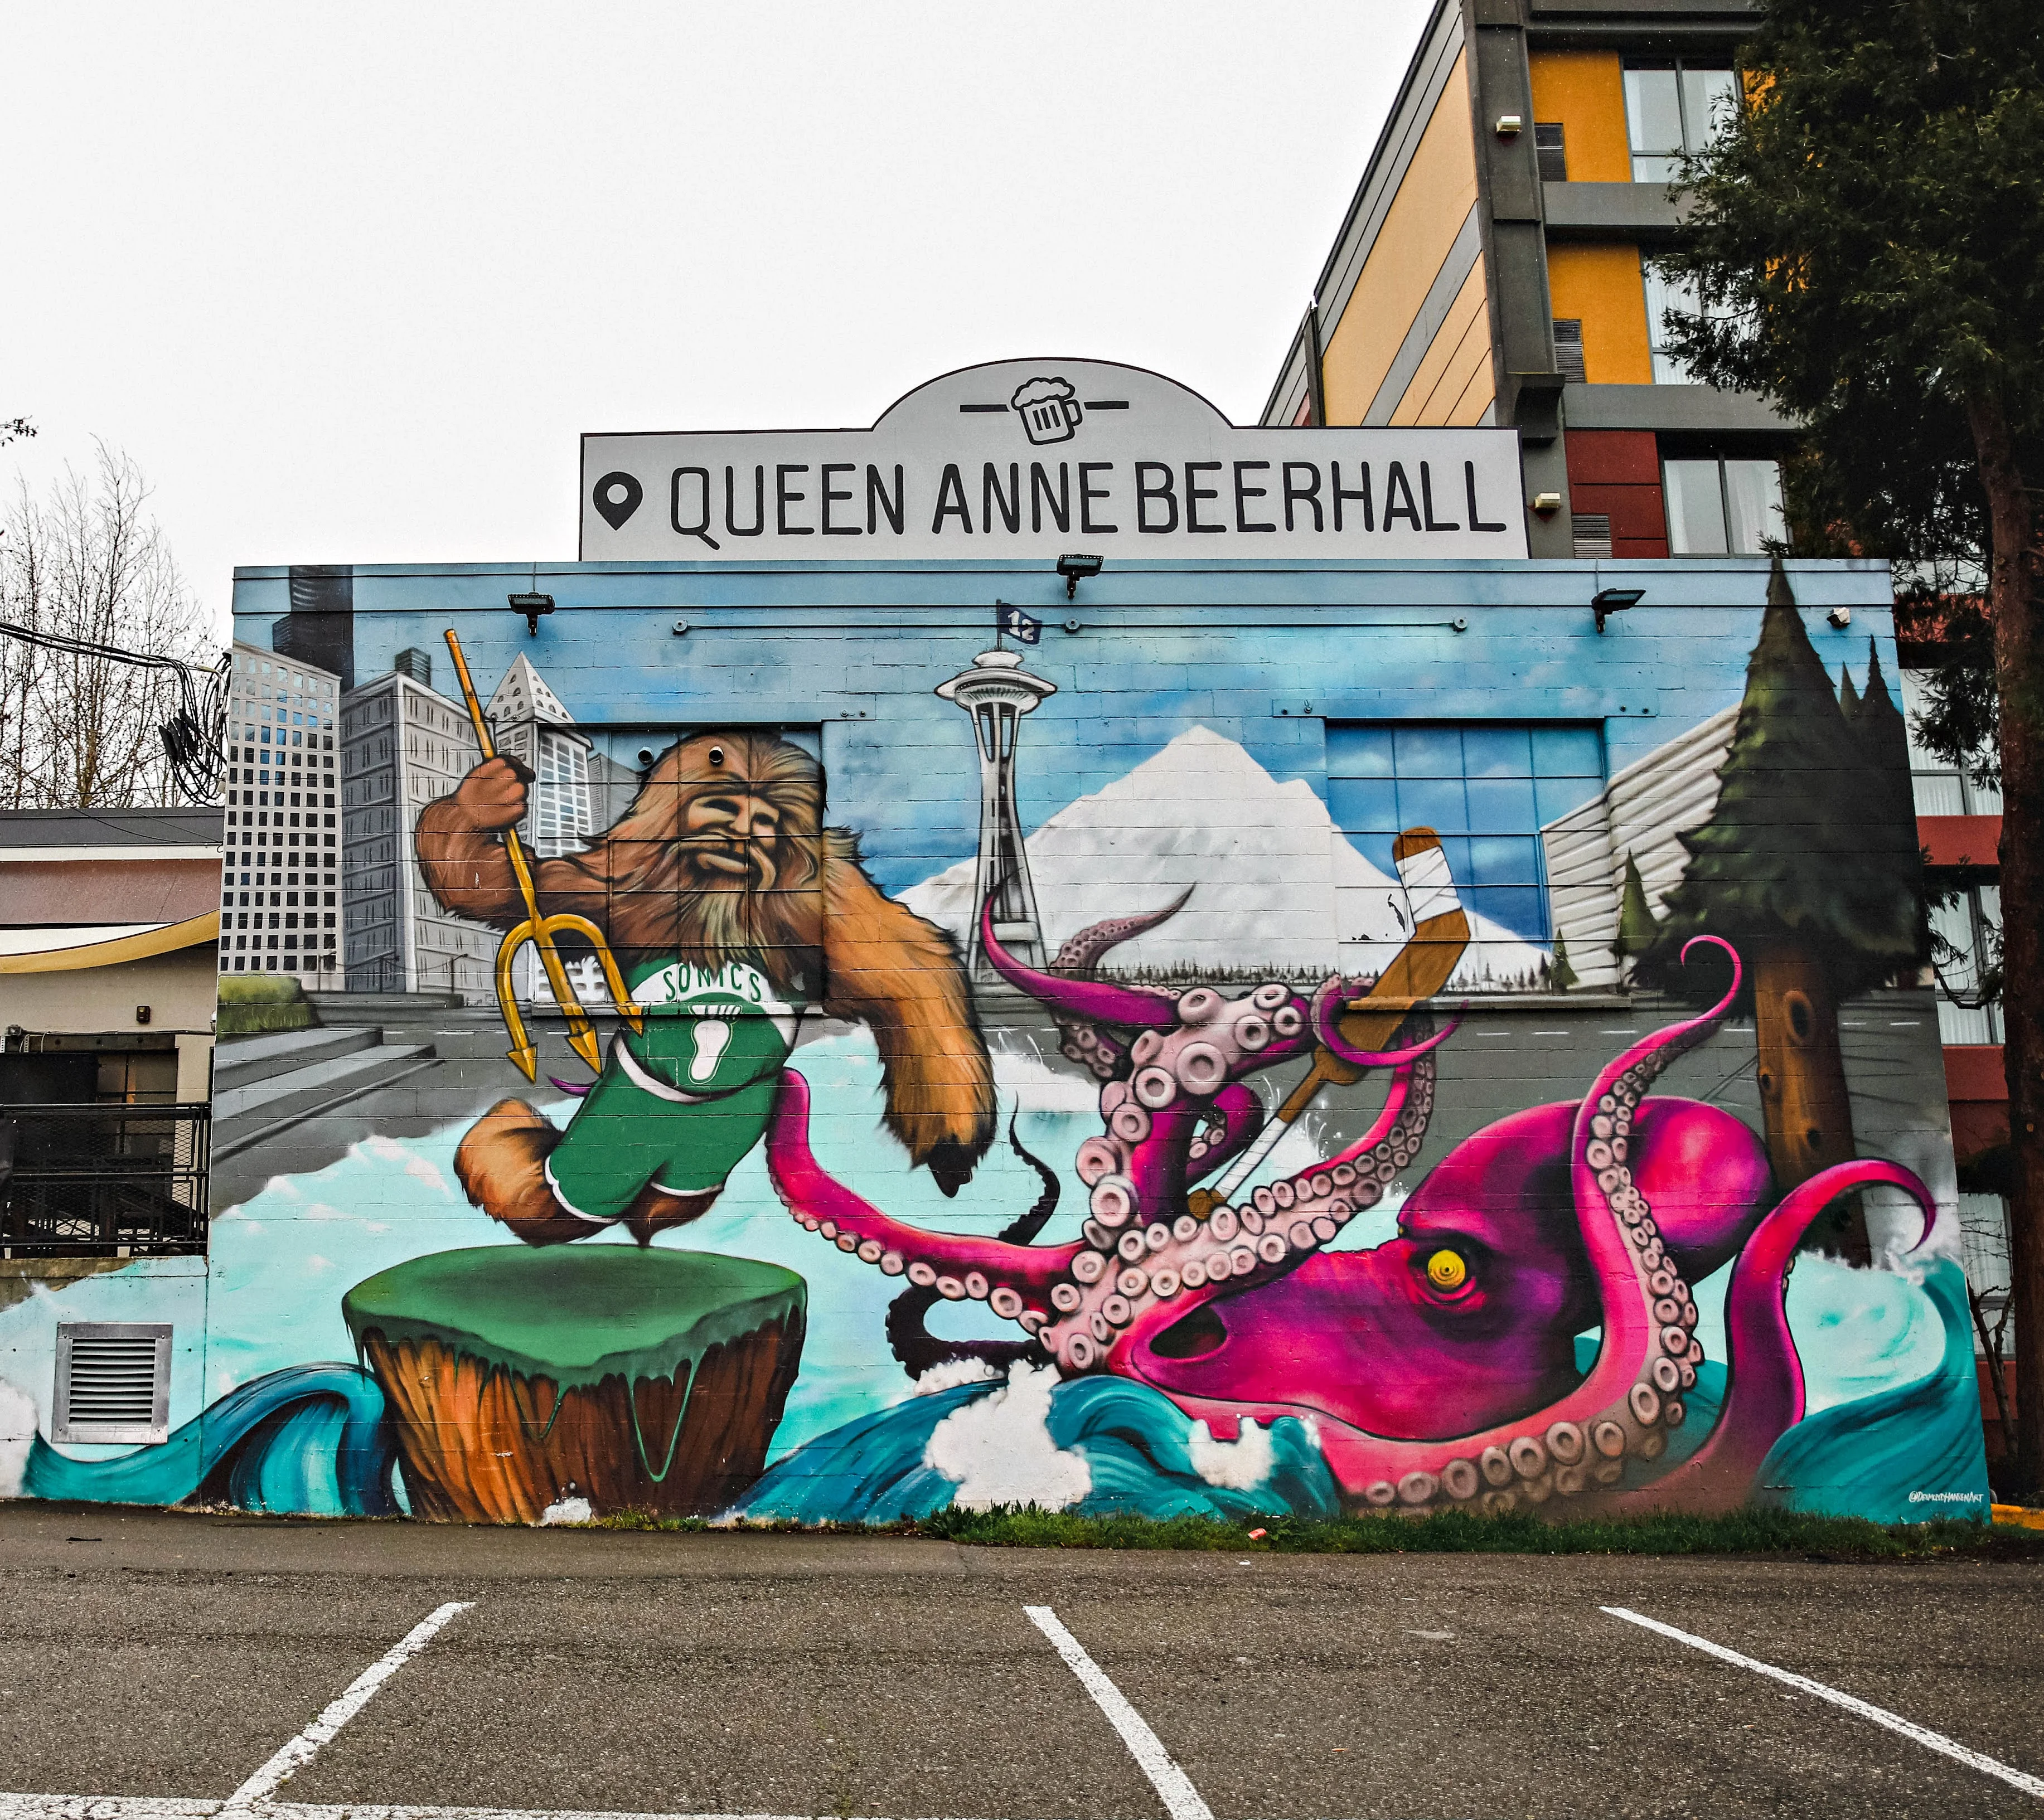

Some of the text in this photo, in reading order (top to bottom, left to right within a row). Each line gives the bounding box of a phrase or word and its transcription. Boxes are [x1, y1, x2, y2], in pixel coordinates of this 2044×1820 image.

[671, 460, 1507, 551] QUEEN ANNE BEERHALL
[1008, 610, 1035, 641] 12
[663, 964, 762, 1001] SONICS
